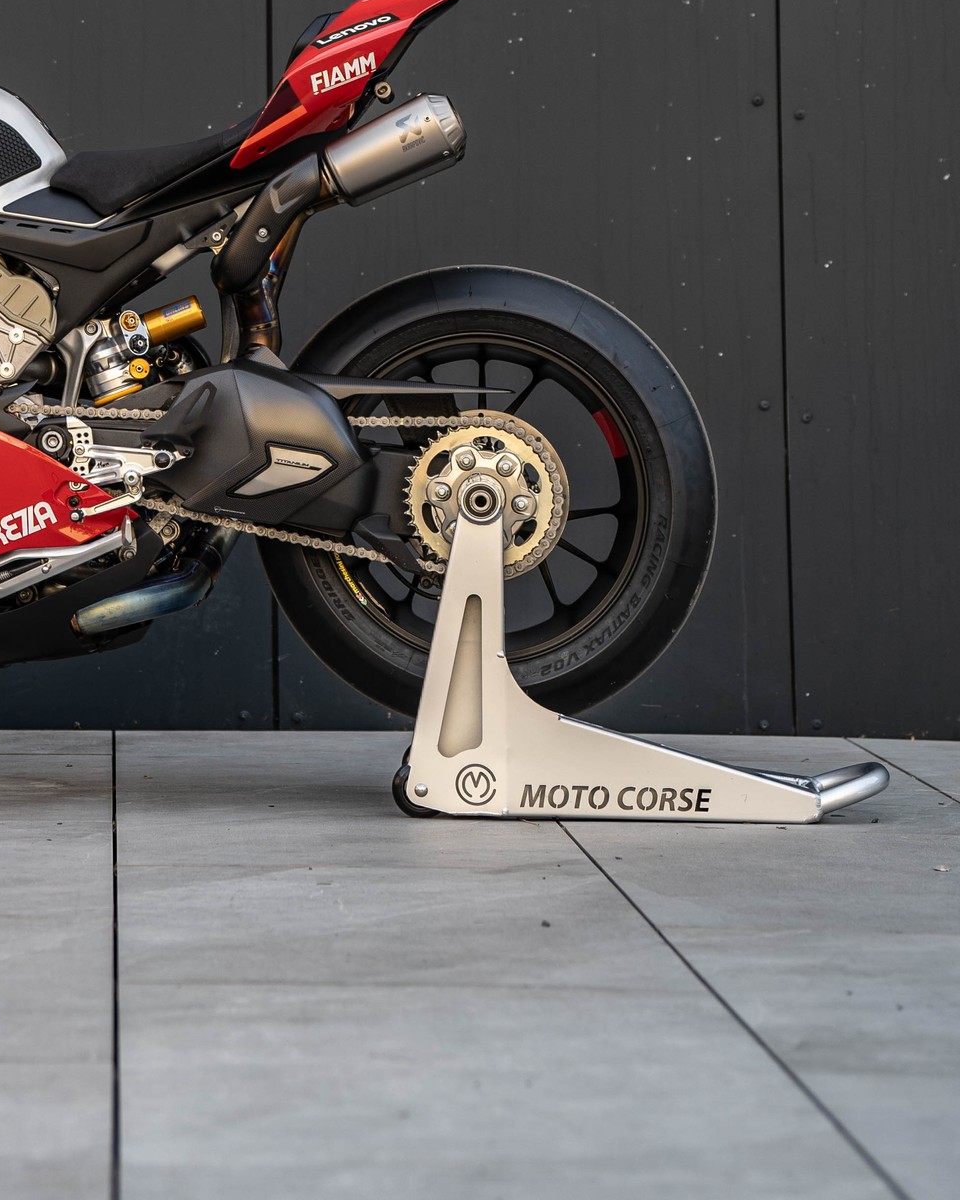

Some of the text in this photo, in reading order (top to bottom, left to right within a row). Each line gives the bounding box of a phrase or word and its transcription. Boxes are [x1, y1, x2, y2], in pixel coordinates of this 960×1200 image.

[316, 15, 392, 46] Lenovo
[310, 52, 377, 93] FIAMM
[642, 513, 668, 591] RACING
[583, 592, 642, 654] BATTLAX
[519, 784, 712, 812] MOTO CORSE
